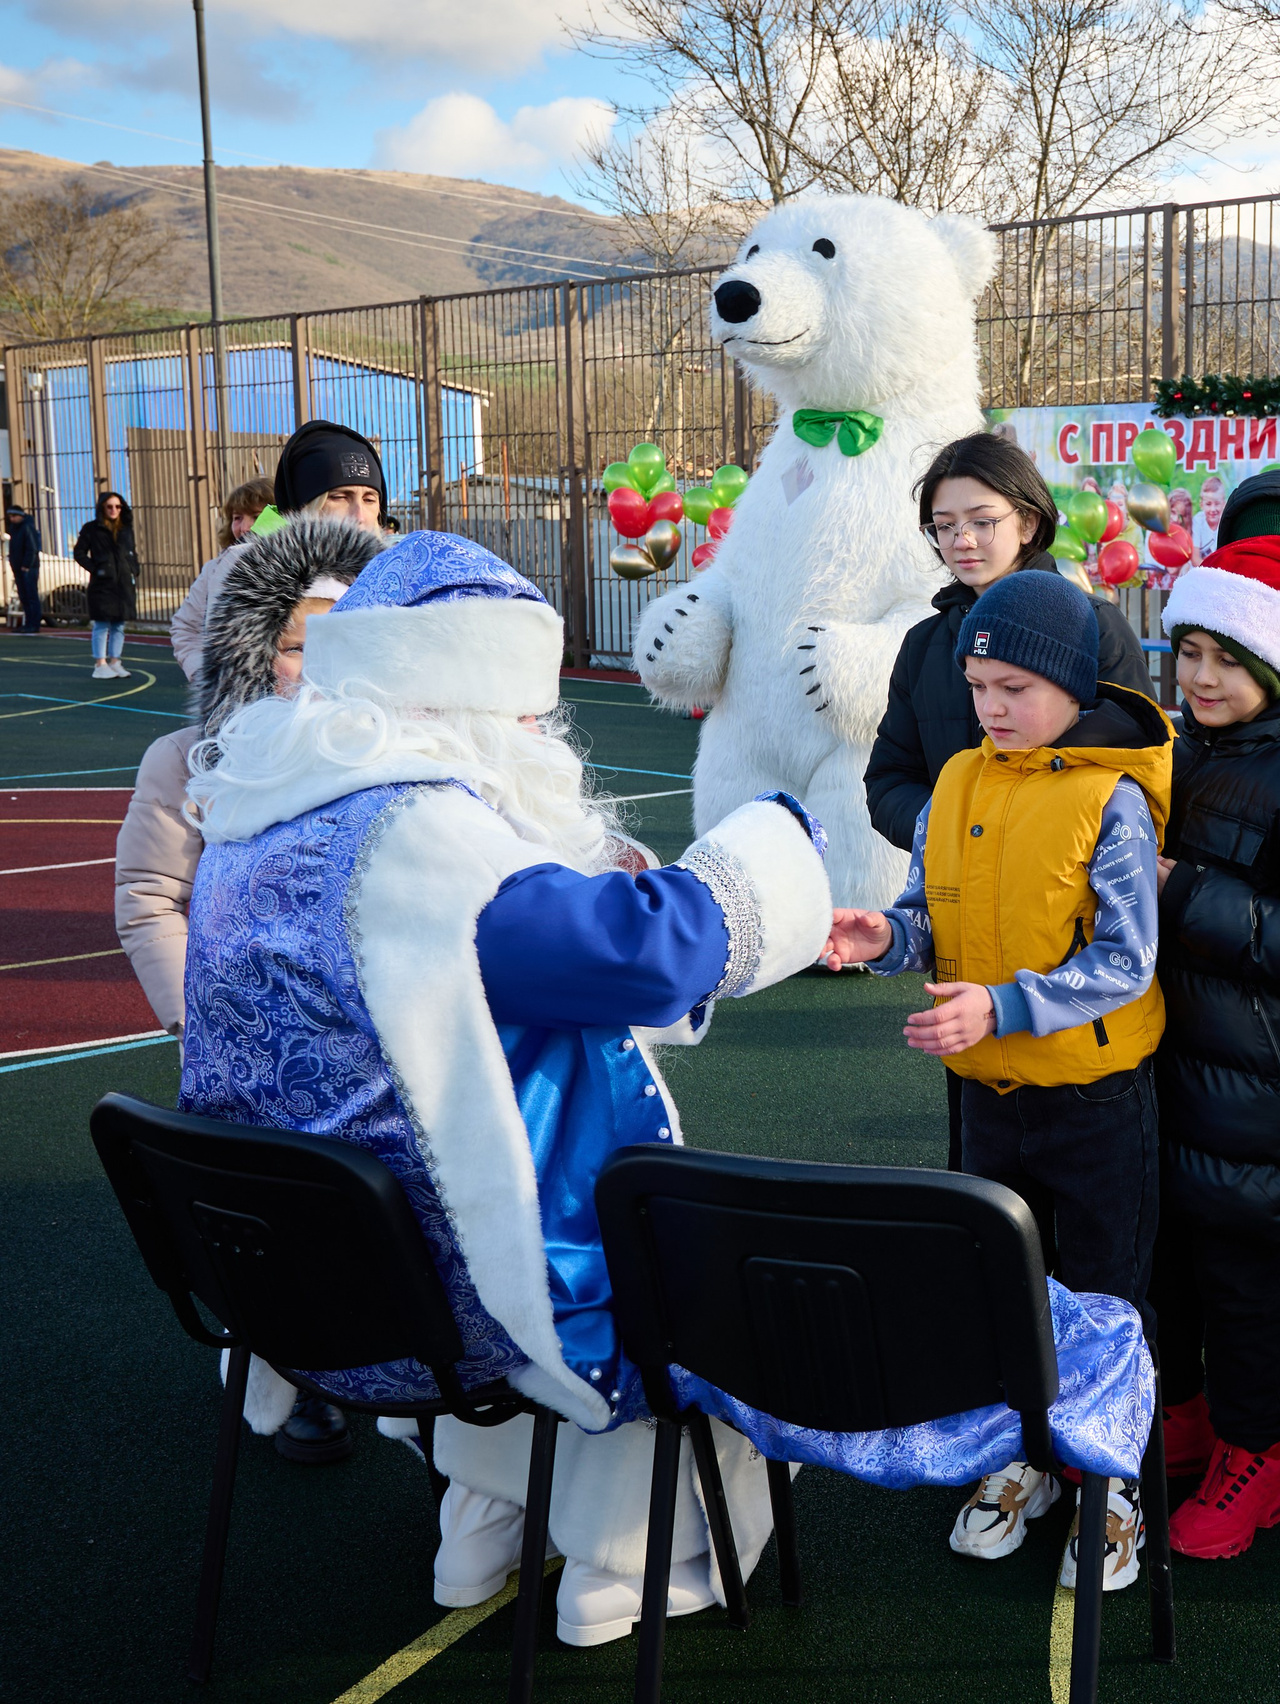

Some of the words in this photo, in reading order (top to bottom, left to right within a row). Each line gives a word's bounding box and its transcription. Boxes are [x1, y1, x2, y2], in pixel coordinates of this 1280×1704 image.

[1058, 423, 1079, 464] С
[1107, 873, 1130, 887] POPULAR
[1109, 951, 1132, 971] GO
